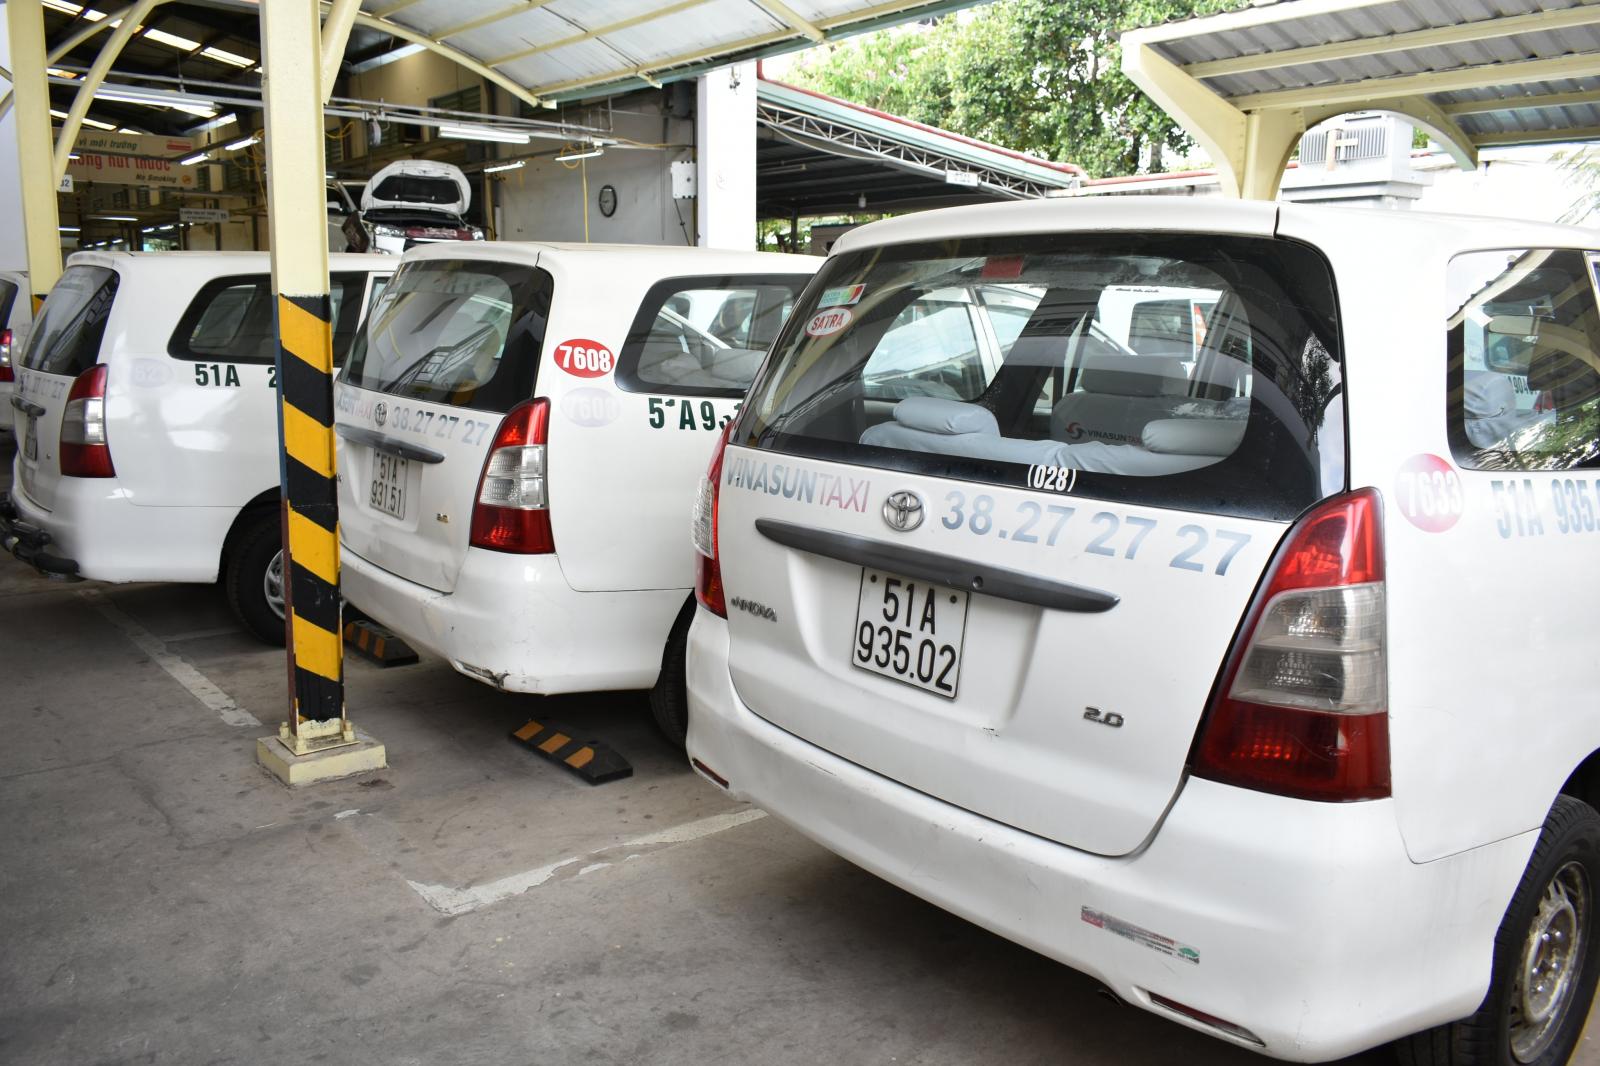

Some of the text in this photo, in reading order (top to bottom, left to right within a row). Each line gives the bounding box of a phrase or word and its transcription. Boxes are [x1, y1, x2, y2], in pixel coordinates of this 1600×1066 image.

[811, 313, 845, 330] SATRA
[195, 363, 241, 387] 51A
[558, 345, 612, 373] 7608
[392, 405, 435, 434] 38.27
[435, 414, 460, 440] 27
[461, 418, 490, 447] 27
[379, 451, 398, 484] 51A
[1027, 463, 1077, 492] (028)
[371, 480, 402, 514] 931.51
[1400, 469, 1463, 518] 7633
[1491, 477, 1600, 540] 51A 935.
[941, 490, 1076, 547] 38.27
[1084, 511, 1158, 560] 27
[1169, 523, 1252, 576] 27
[882, 577, 936, 635] 51A
[857, 620, 957, 692] 935.02
[1083, 706, 1125, 728] 2.0
